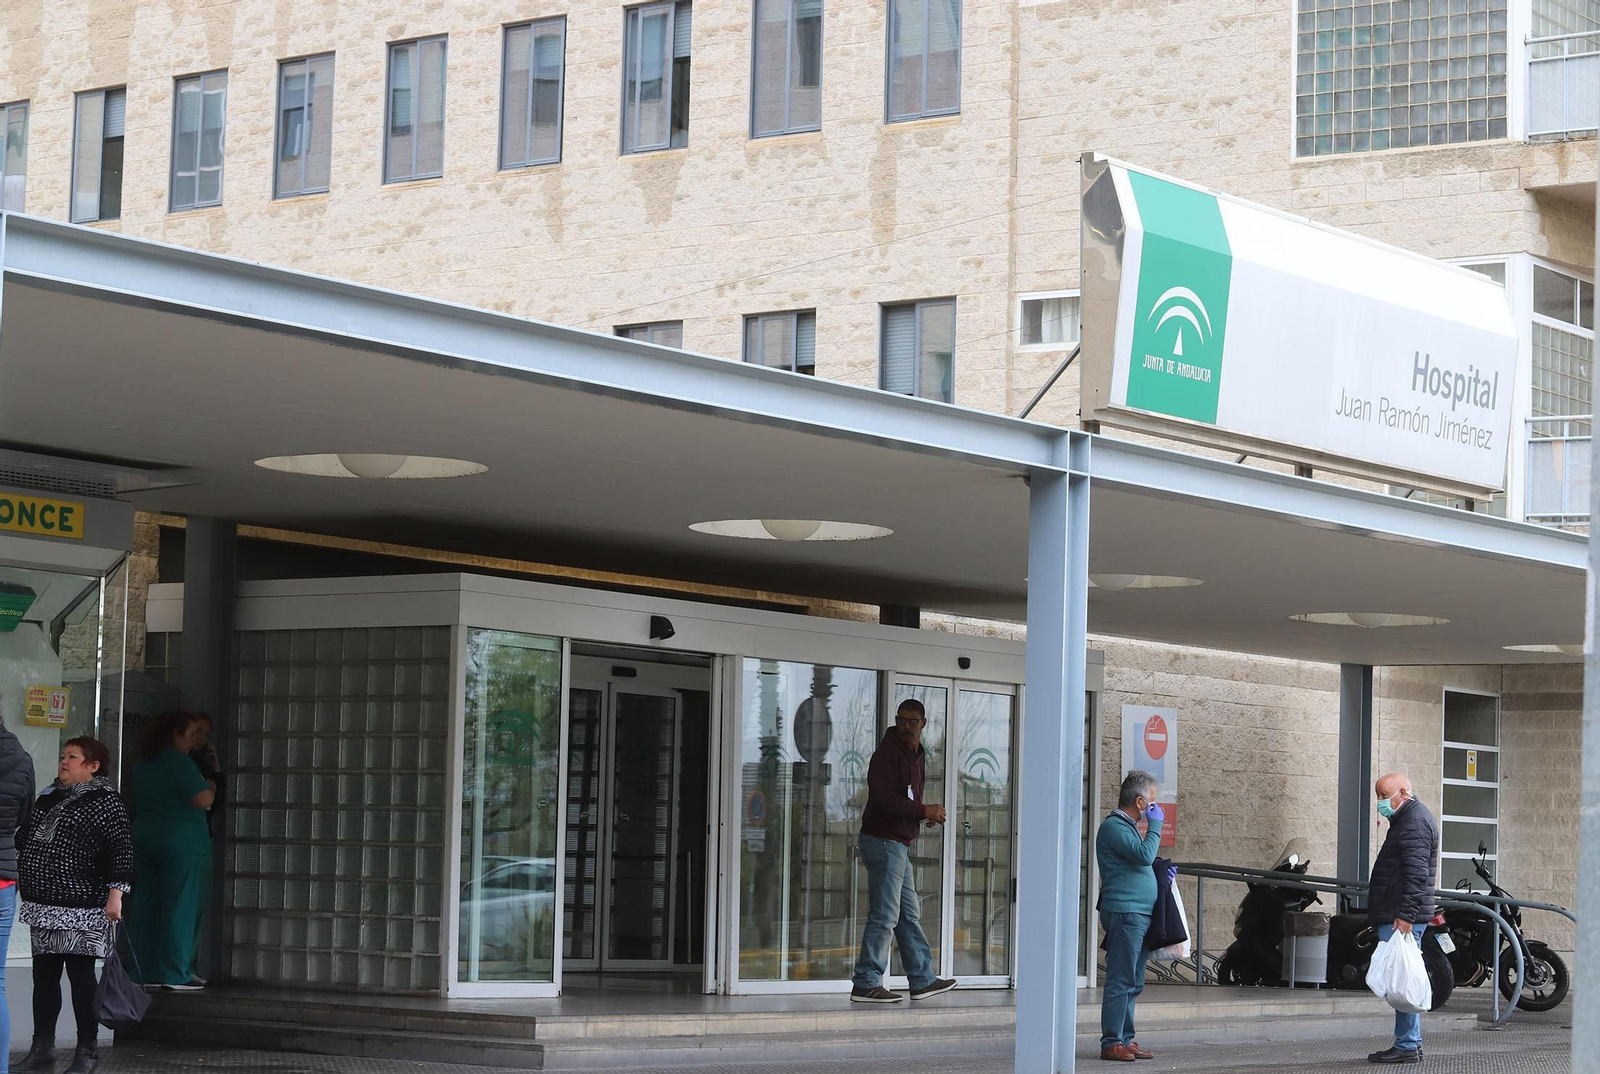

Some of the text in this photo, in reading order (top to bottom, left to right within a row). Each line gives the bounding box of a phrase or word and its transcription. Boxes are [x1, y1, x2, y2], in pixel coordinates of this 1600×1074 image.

[1142, 354, 1164, 372] JUNTA
[1166, 359, 1175, 375] DE
[1412, 351, 1498, 412] Hospital
[1335, 387, 1493, 450] Juan Ramón Jiménez
[0, 498, 74, 532] ONCE
